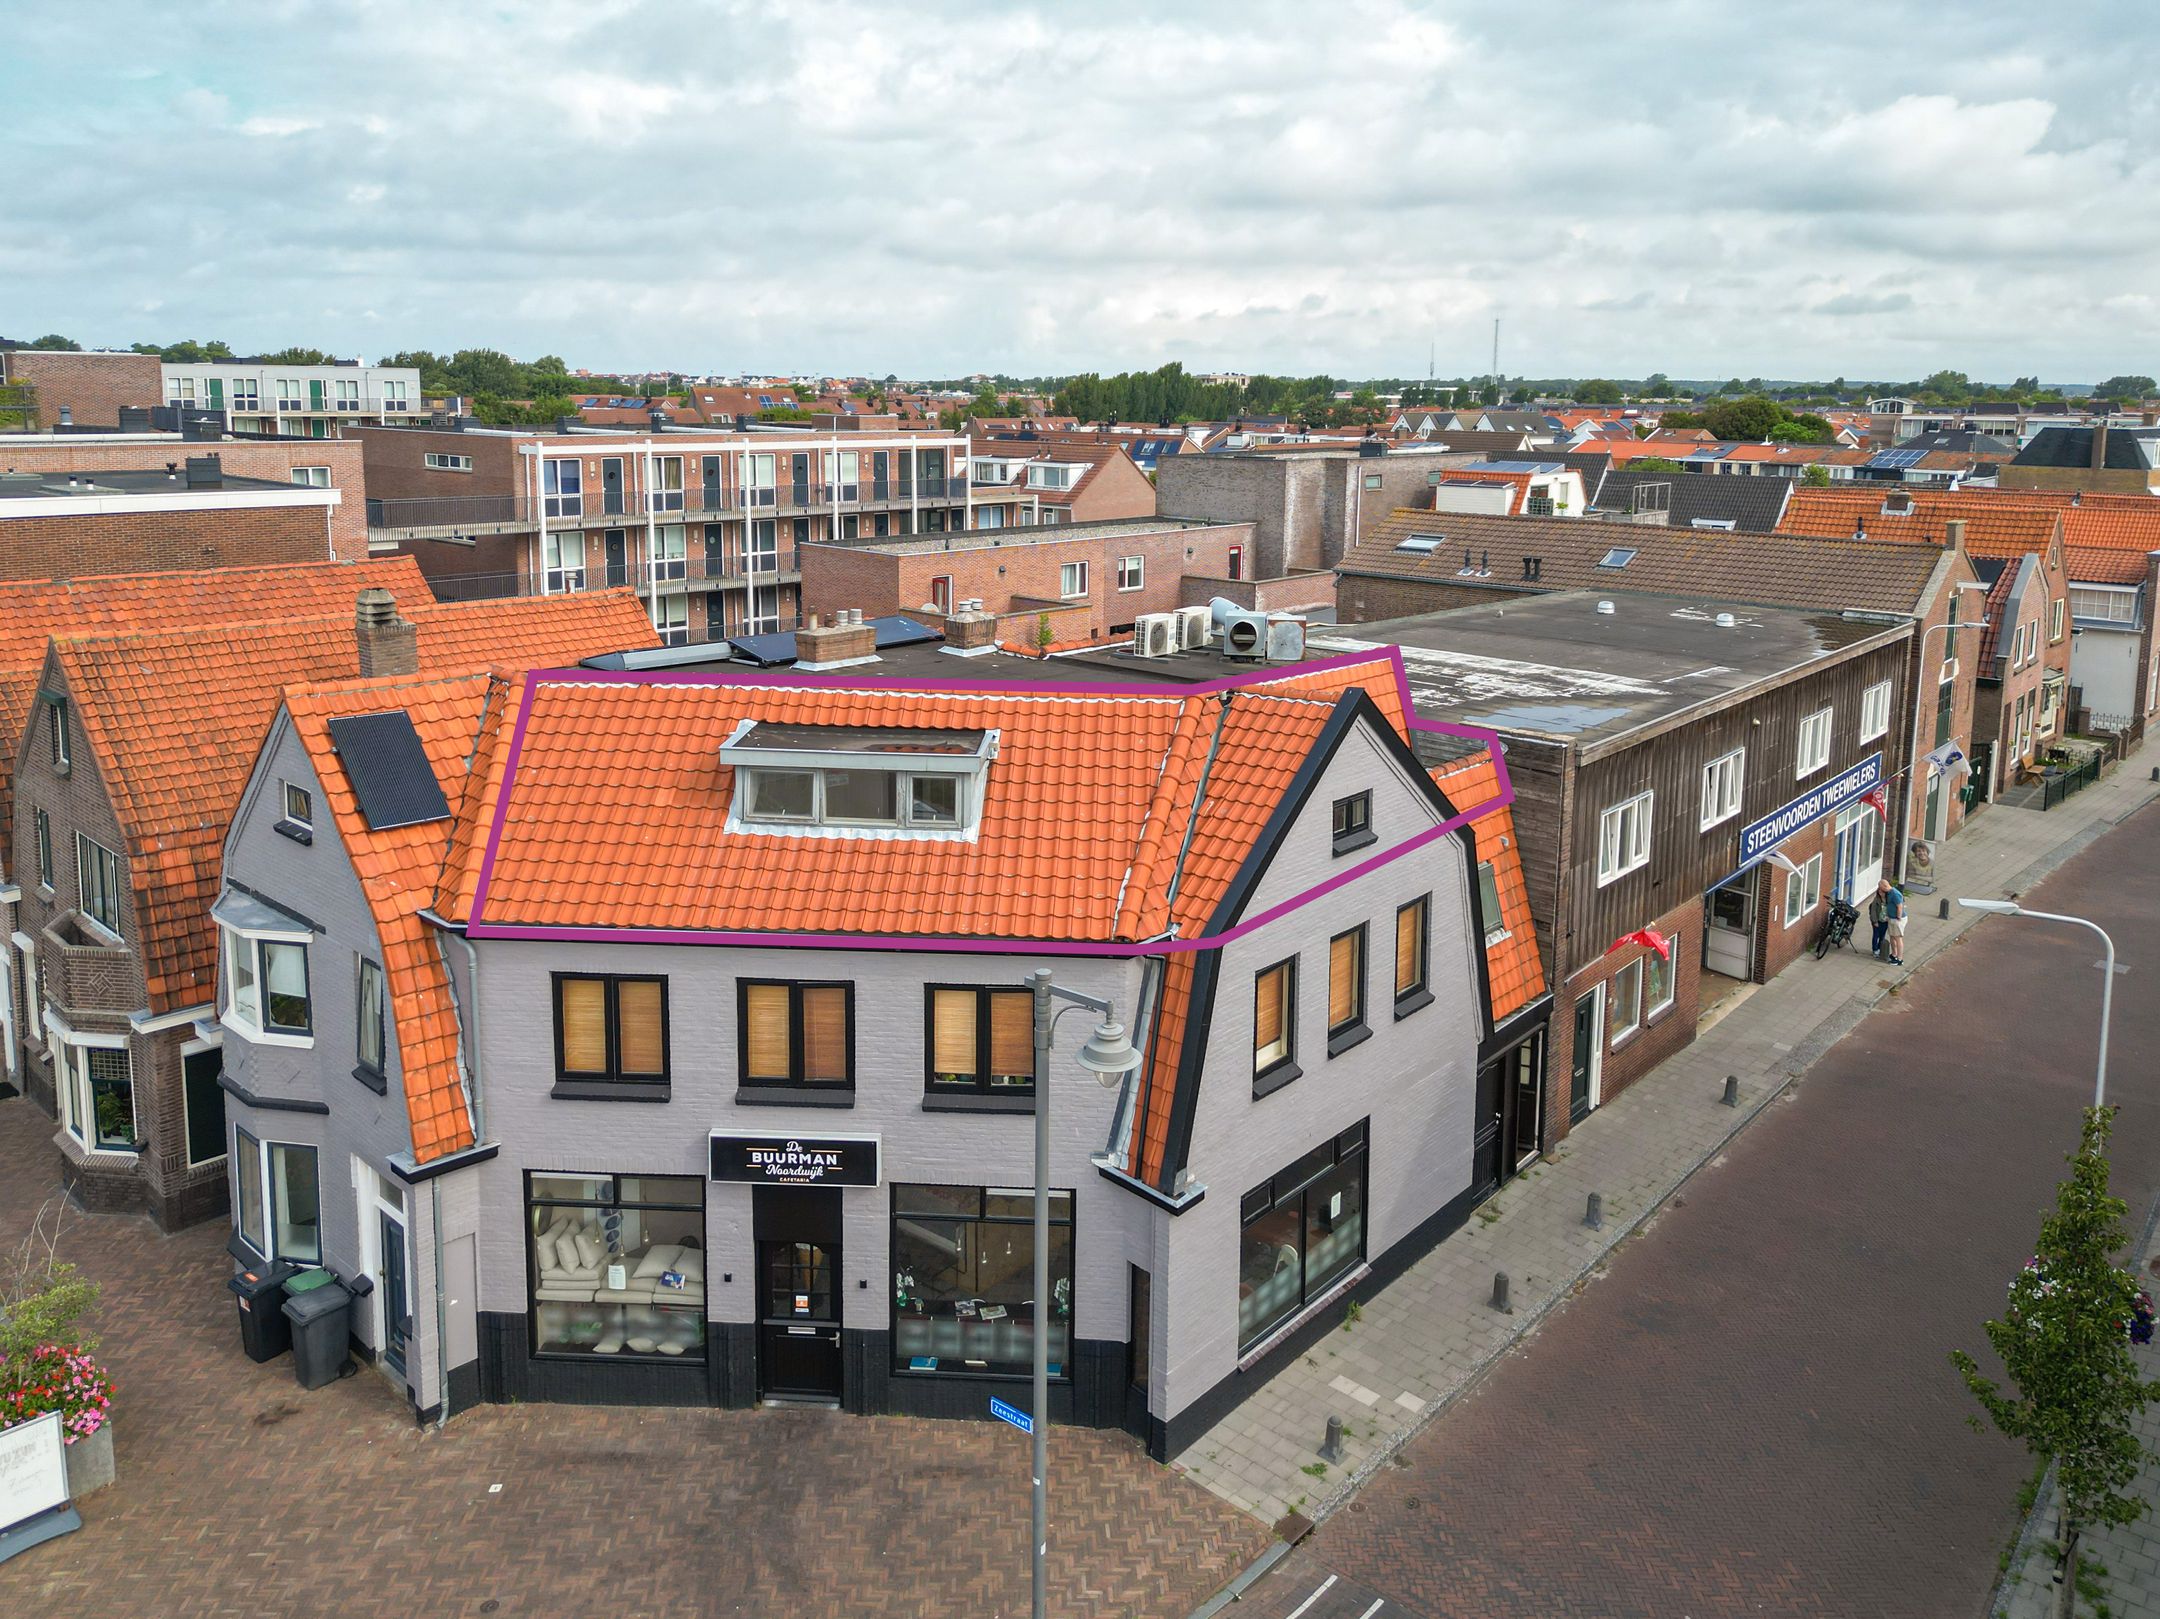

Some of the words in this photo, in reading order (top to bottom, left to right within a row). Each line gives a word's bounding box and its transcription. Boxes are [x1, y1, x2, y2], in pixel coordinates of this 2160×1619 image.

[1747, 793, 1821, 854] STEENVOORDEN
[1822, 761, 1876, 808] TWEEWIELERS
[786, 1140, 803, 1153] De
[752, 1152, 837, 1165] BUURMAN
[765, 1164, 824, 1180] Noordwijk
[994, 1404, 1028, 1428] Zeestraat
